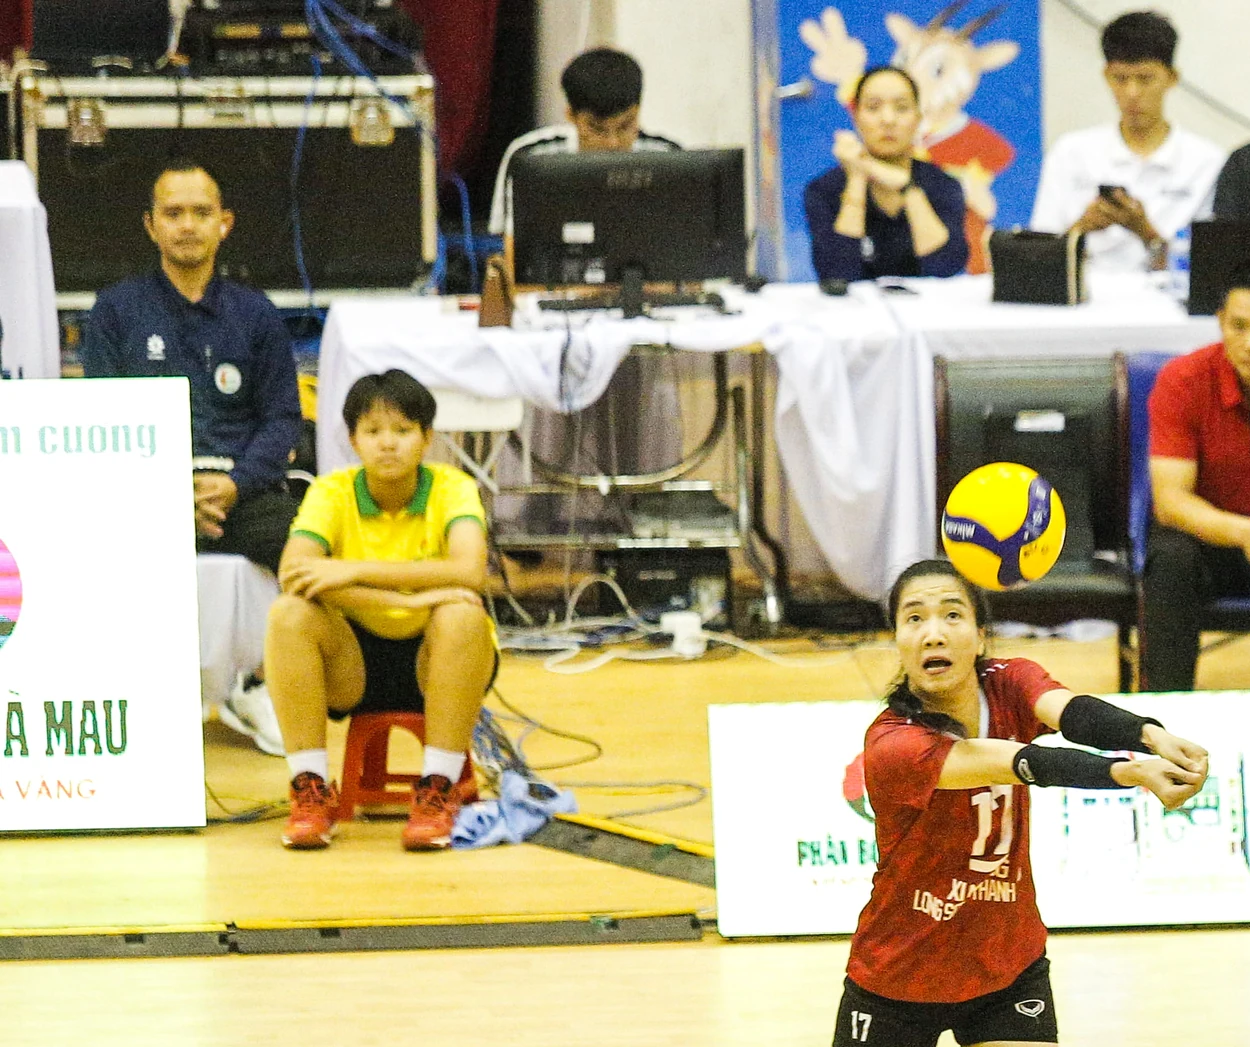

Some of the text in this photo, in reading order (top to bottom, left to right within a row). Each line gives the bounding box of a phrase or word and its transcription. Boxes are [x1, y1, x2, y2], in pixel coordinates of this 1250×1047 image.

[38, 424, 157, 458] cuong
[4, 689, 128, 757] À MAU
[912, 889, 944, 921] LONG
[851, 1011, 872, 1042] 17
